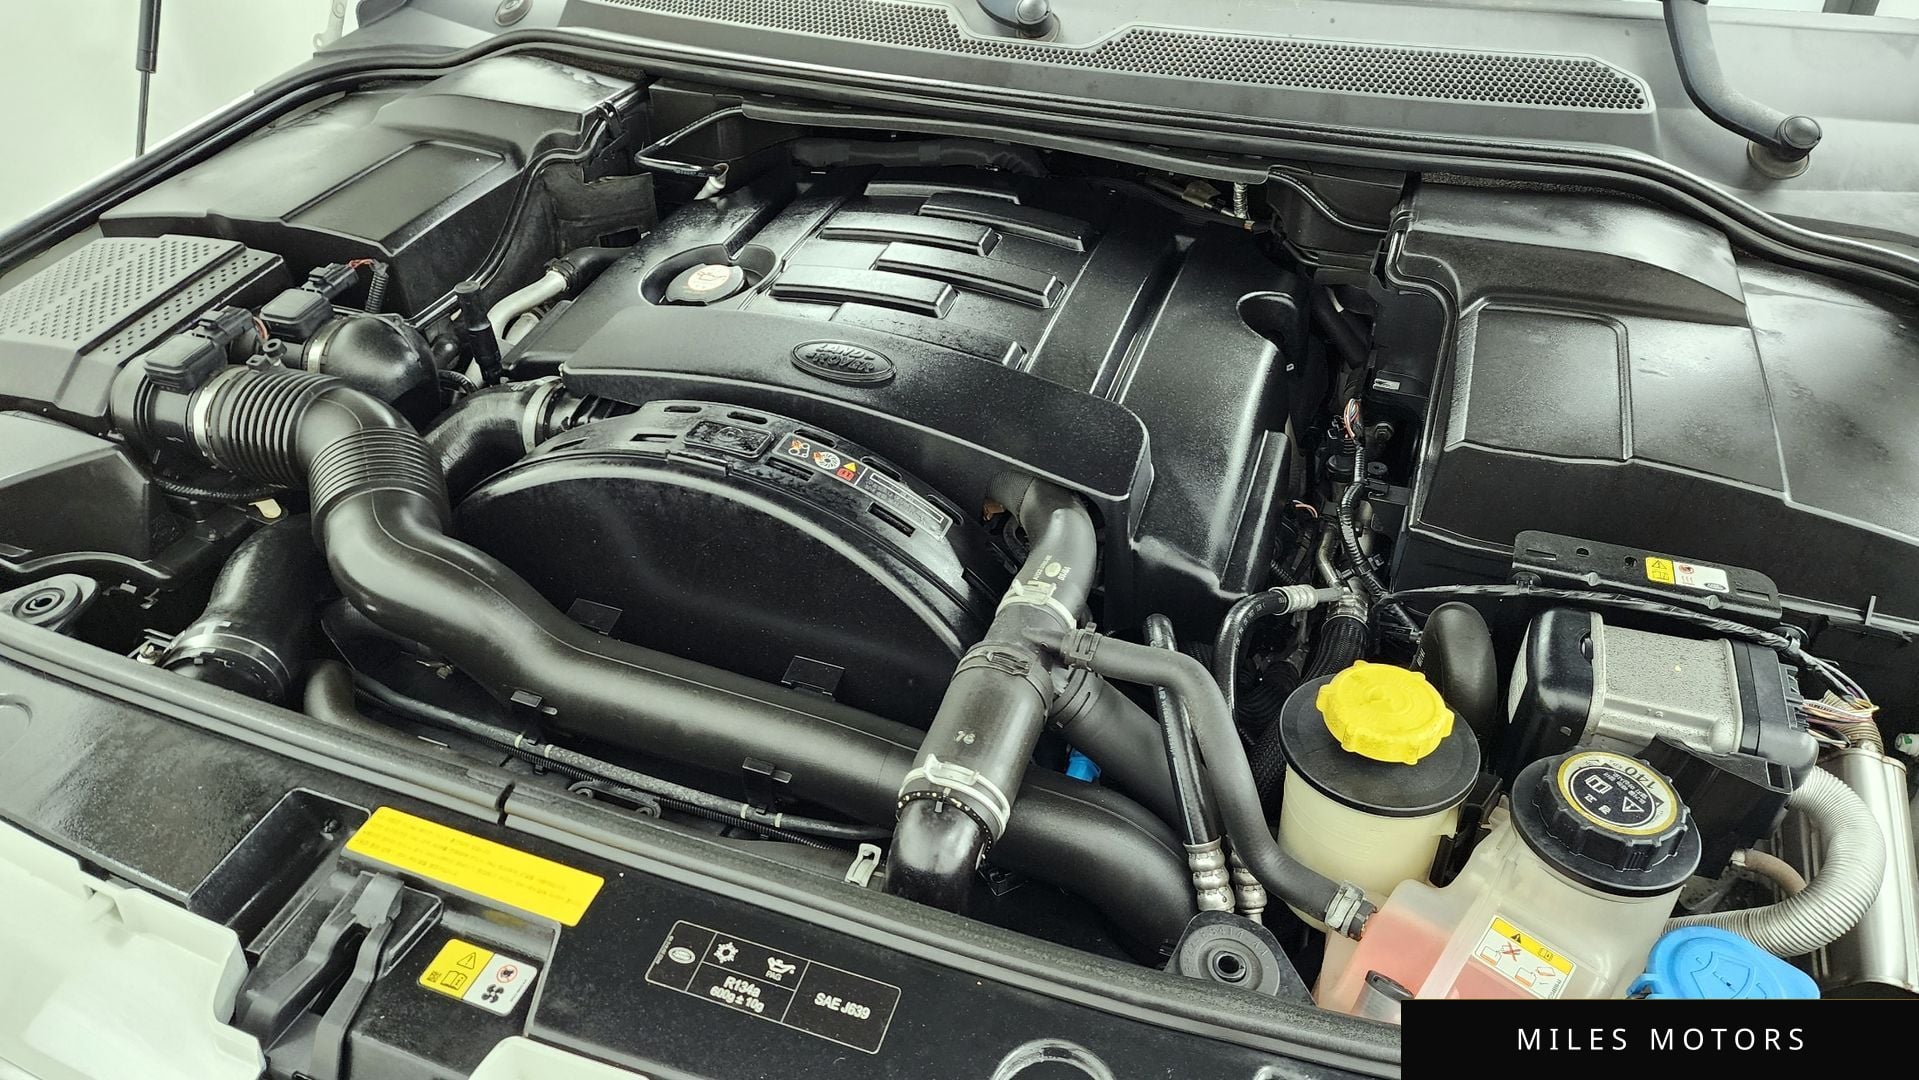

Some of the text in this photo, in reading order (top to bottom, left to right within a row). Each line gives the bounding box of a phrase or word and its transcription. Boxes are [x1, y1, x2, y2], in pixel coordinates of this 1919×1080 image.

[1625, 766, 1655, 789] 140
[723, 975, 761, 997] R134a
[765, 970, 782, 981] PAG
[709, 986, 735, 1003] 600g
[745, 997, 765, 1013] 10g
[814, 992, 871, 1020] SAE J639
